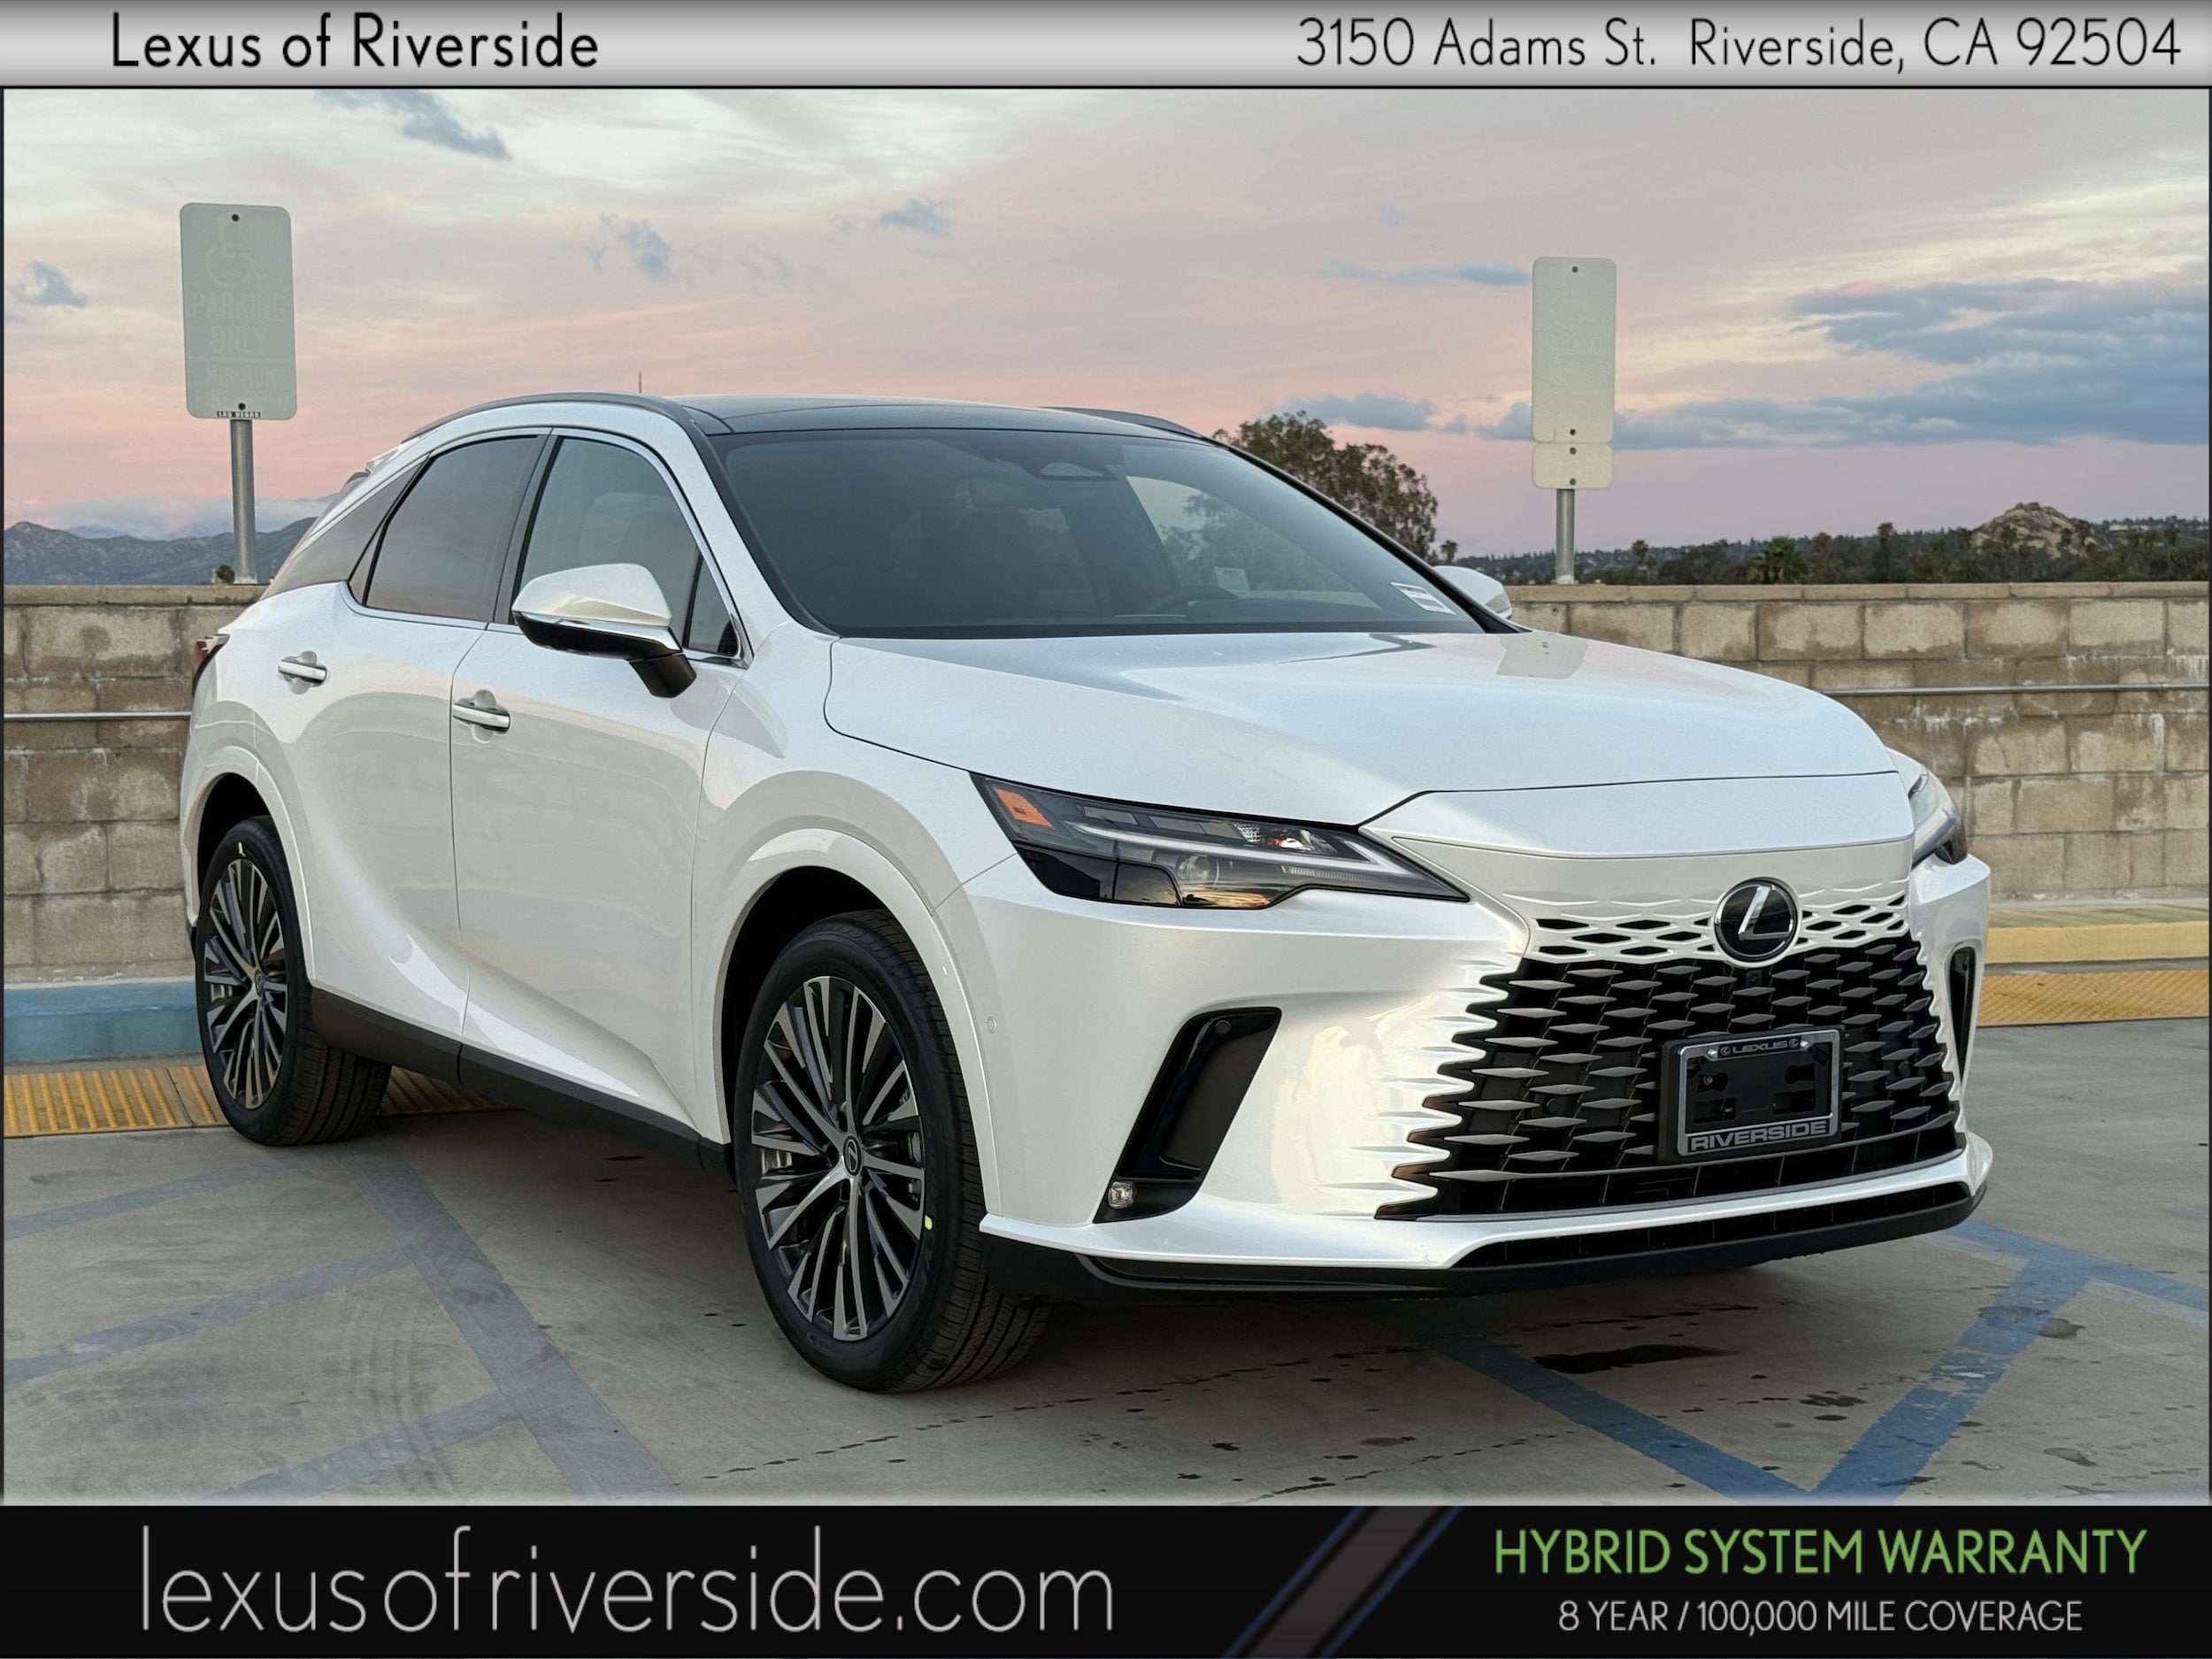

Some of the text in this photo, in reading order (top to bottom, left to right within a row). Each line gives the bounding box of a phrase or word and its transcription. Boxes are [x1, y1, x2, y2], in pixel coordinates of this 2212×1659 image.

[192, 290, 286, 321] PARKING
[211, 325, 268, 355] ONLY
[1732, 1040, 1788, 1053] LEXUS
[1690, 1120, 1827, 1151] RIVERSIDE
